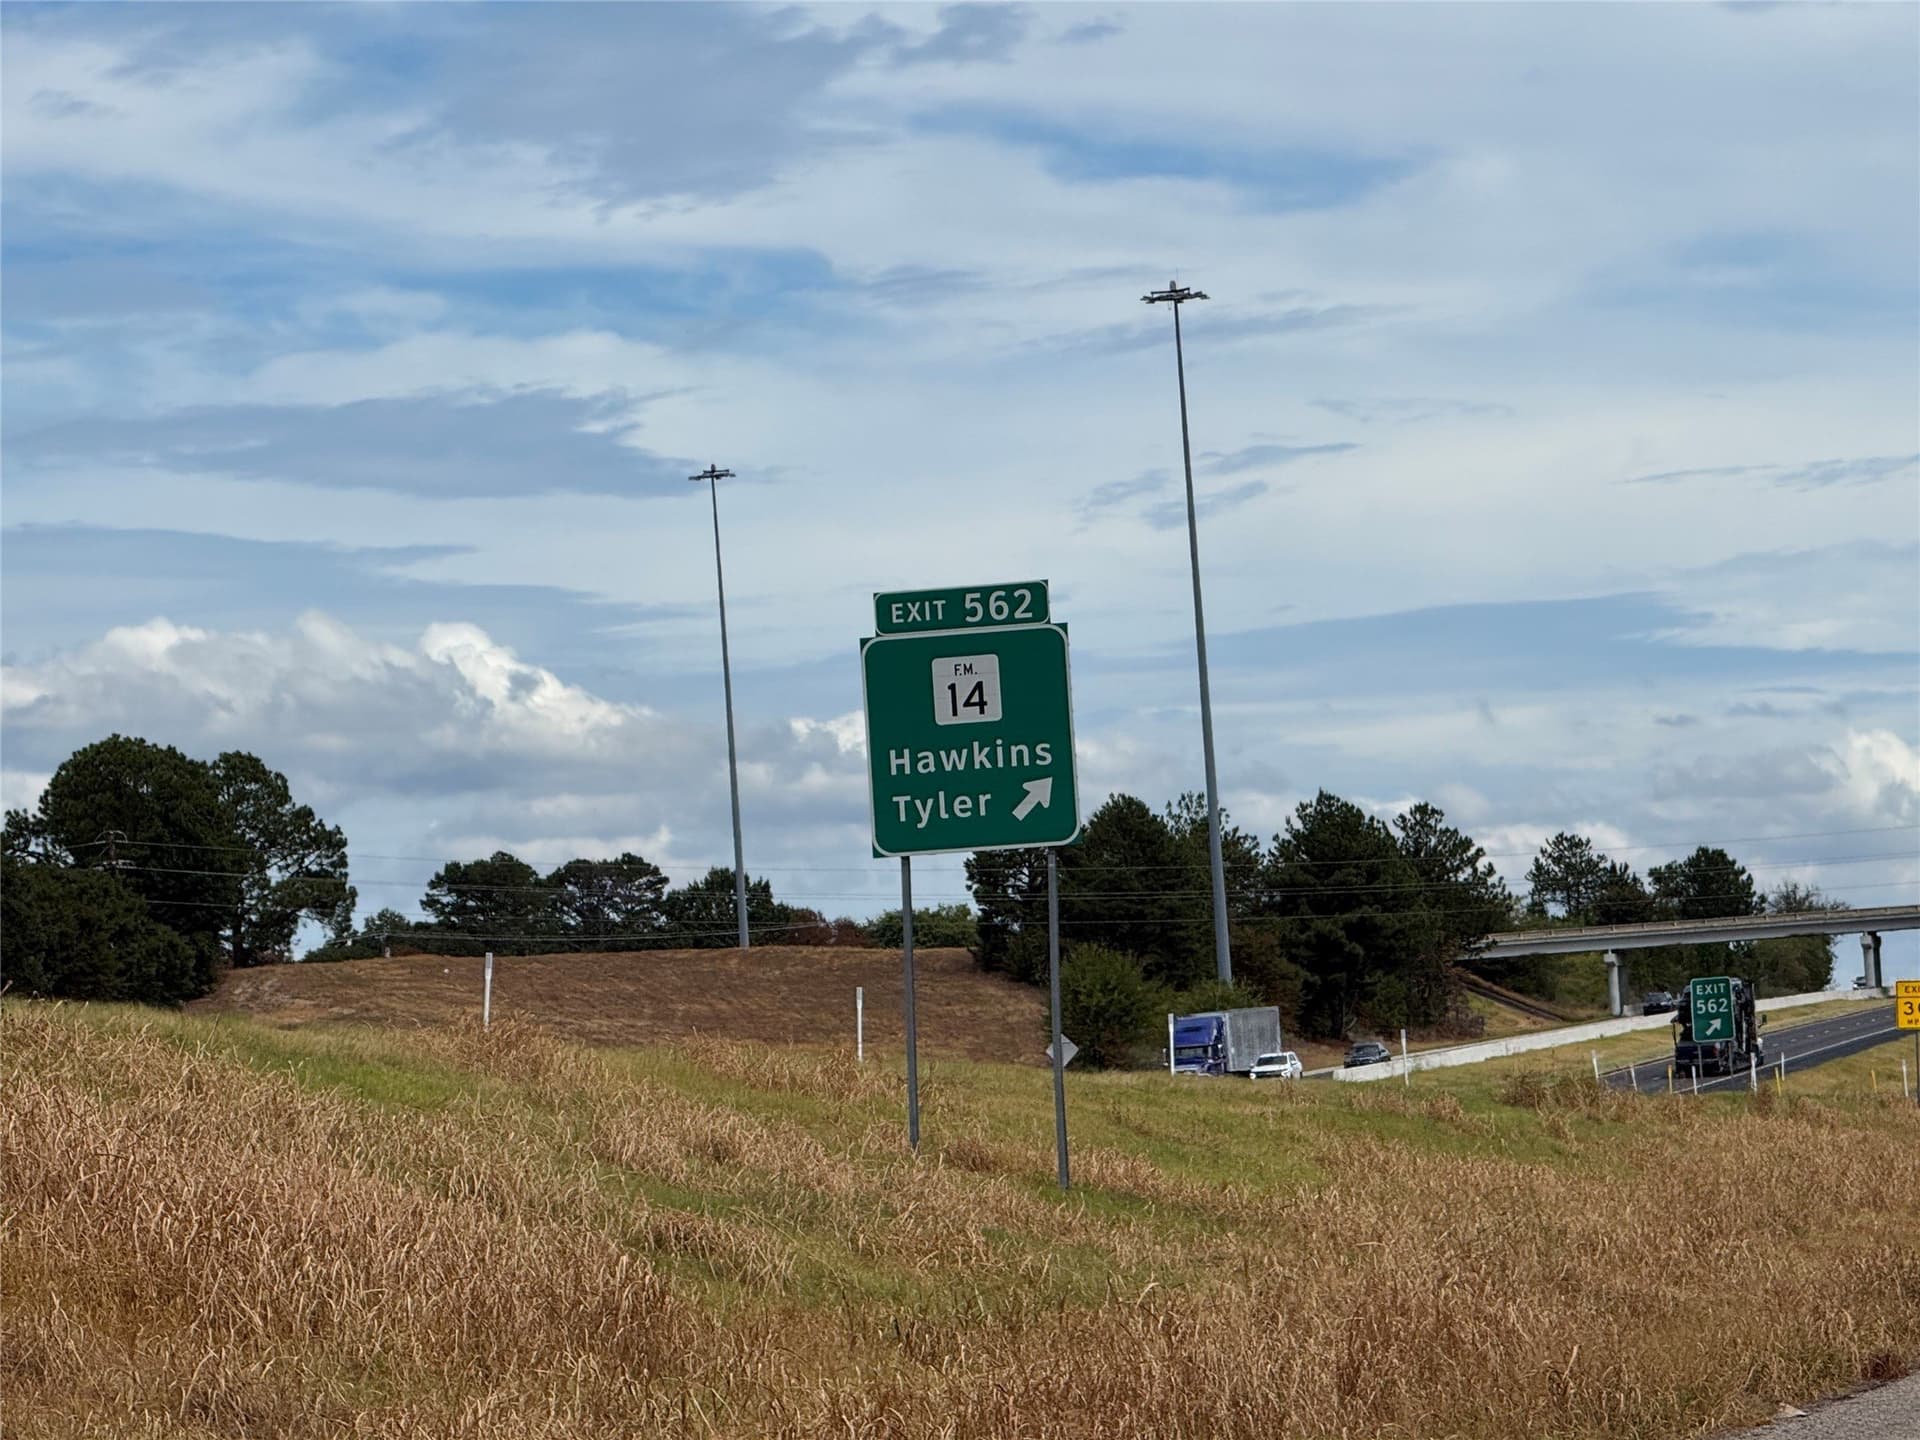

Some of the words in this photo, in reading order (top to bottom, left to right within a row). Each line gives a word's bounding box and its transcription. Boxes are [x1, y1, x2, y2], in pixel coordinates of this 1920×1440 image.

[891, 600, 946, 624] EXIT
[964, 588, 1033, 623] 562
[953, 663, 978, 676] F.M.
[947, 680, 988, 717] 14
[889, 739, 1053, 776] Hawkins
[892, 790, 992, 829] Tyler
[1696, 983, 1726, 995] EXIT
[1696, 998, 1729, 1014] 562
